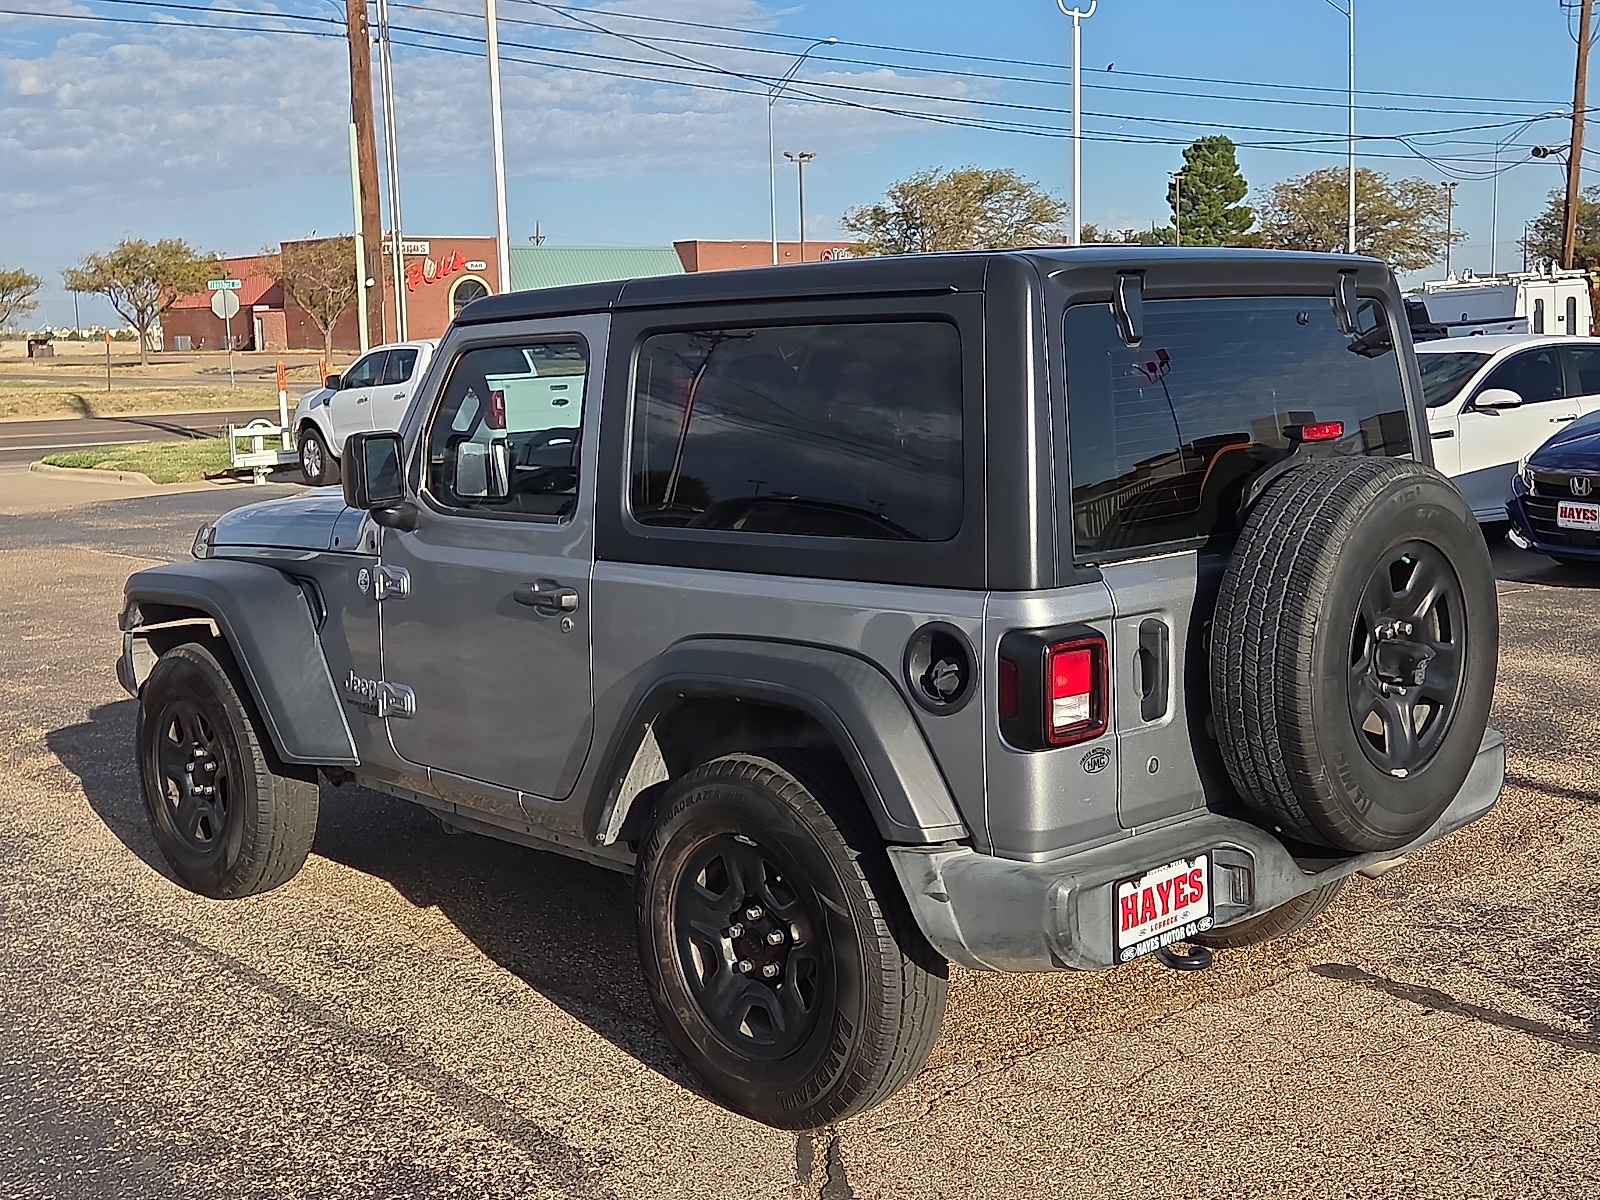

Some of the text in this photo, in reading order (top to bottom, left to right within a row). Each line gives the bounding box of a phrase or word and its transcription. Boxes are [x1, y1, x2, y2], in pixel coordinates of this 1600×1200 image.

[1559, 506, 1598, 522] HAYES
[344, 669, 377, 701] Jeep
[1121, 868, 1204, 932] HAYES
[1136, 936, 1160, 957] HAYES
[1160, 925, 1186, 948] MOTOR
